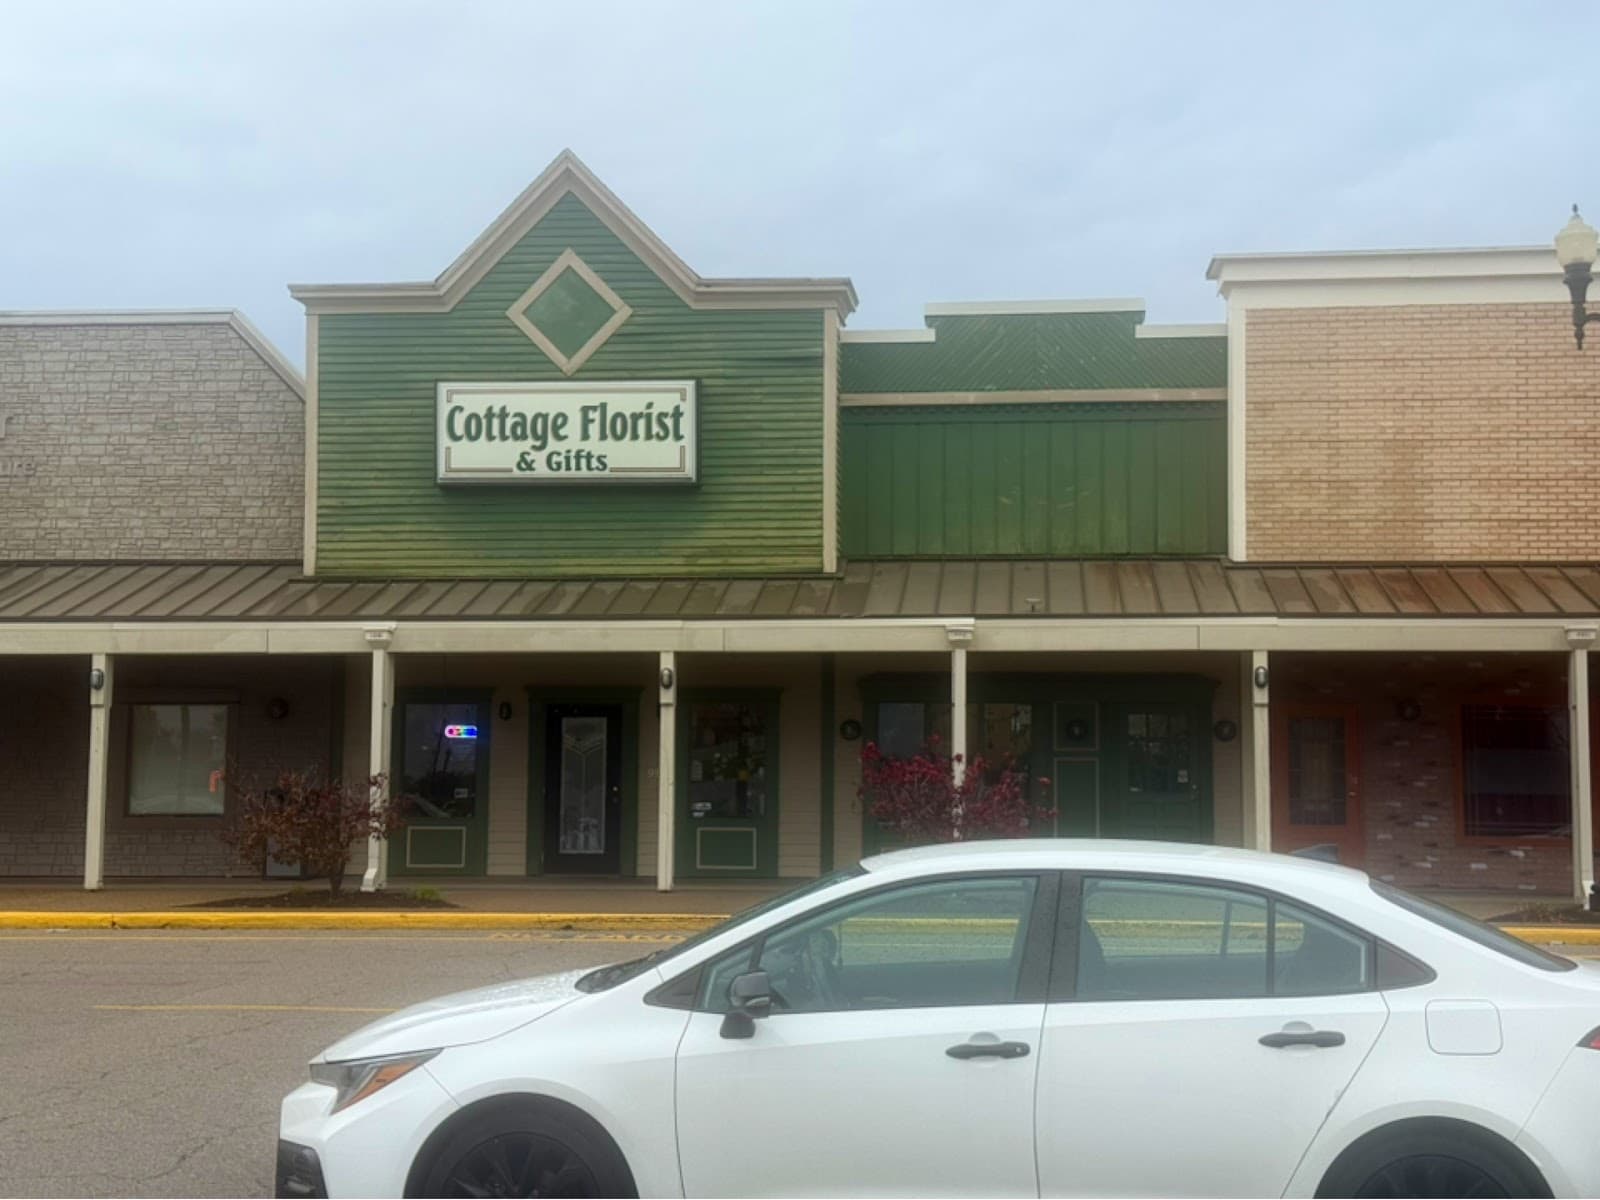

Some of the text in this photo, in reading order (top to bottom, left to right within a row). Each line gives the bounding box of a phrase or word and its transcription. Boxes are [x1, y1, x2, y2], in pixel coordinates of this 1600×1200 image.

[446, 402, 685, 451] Cottage Florist
[515, 449, 608, 472] & Gifts
